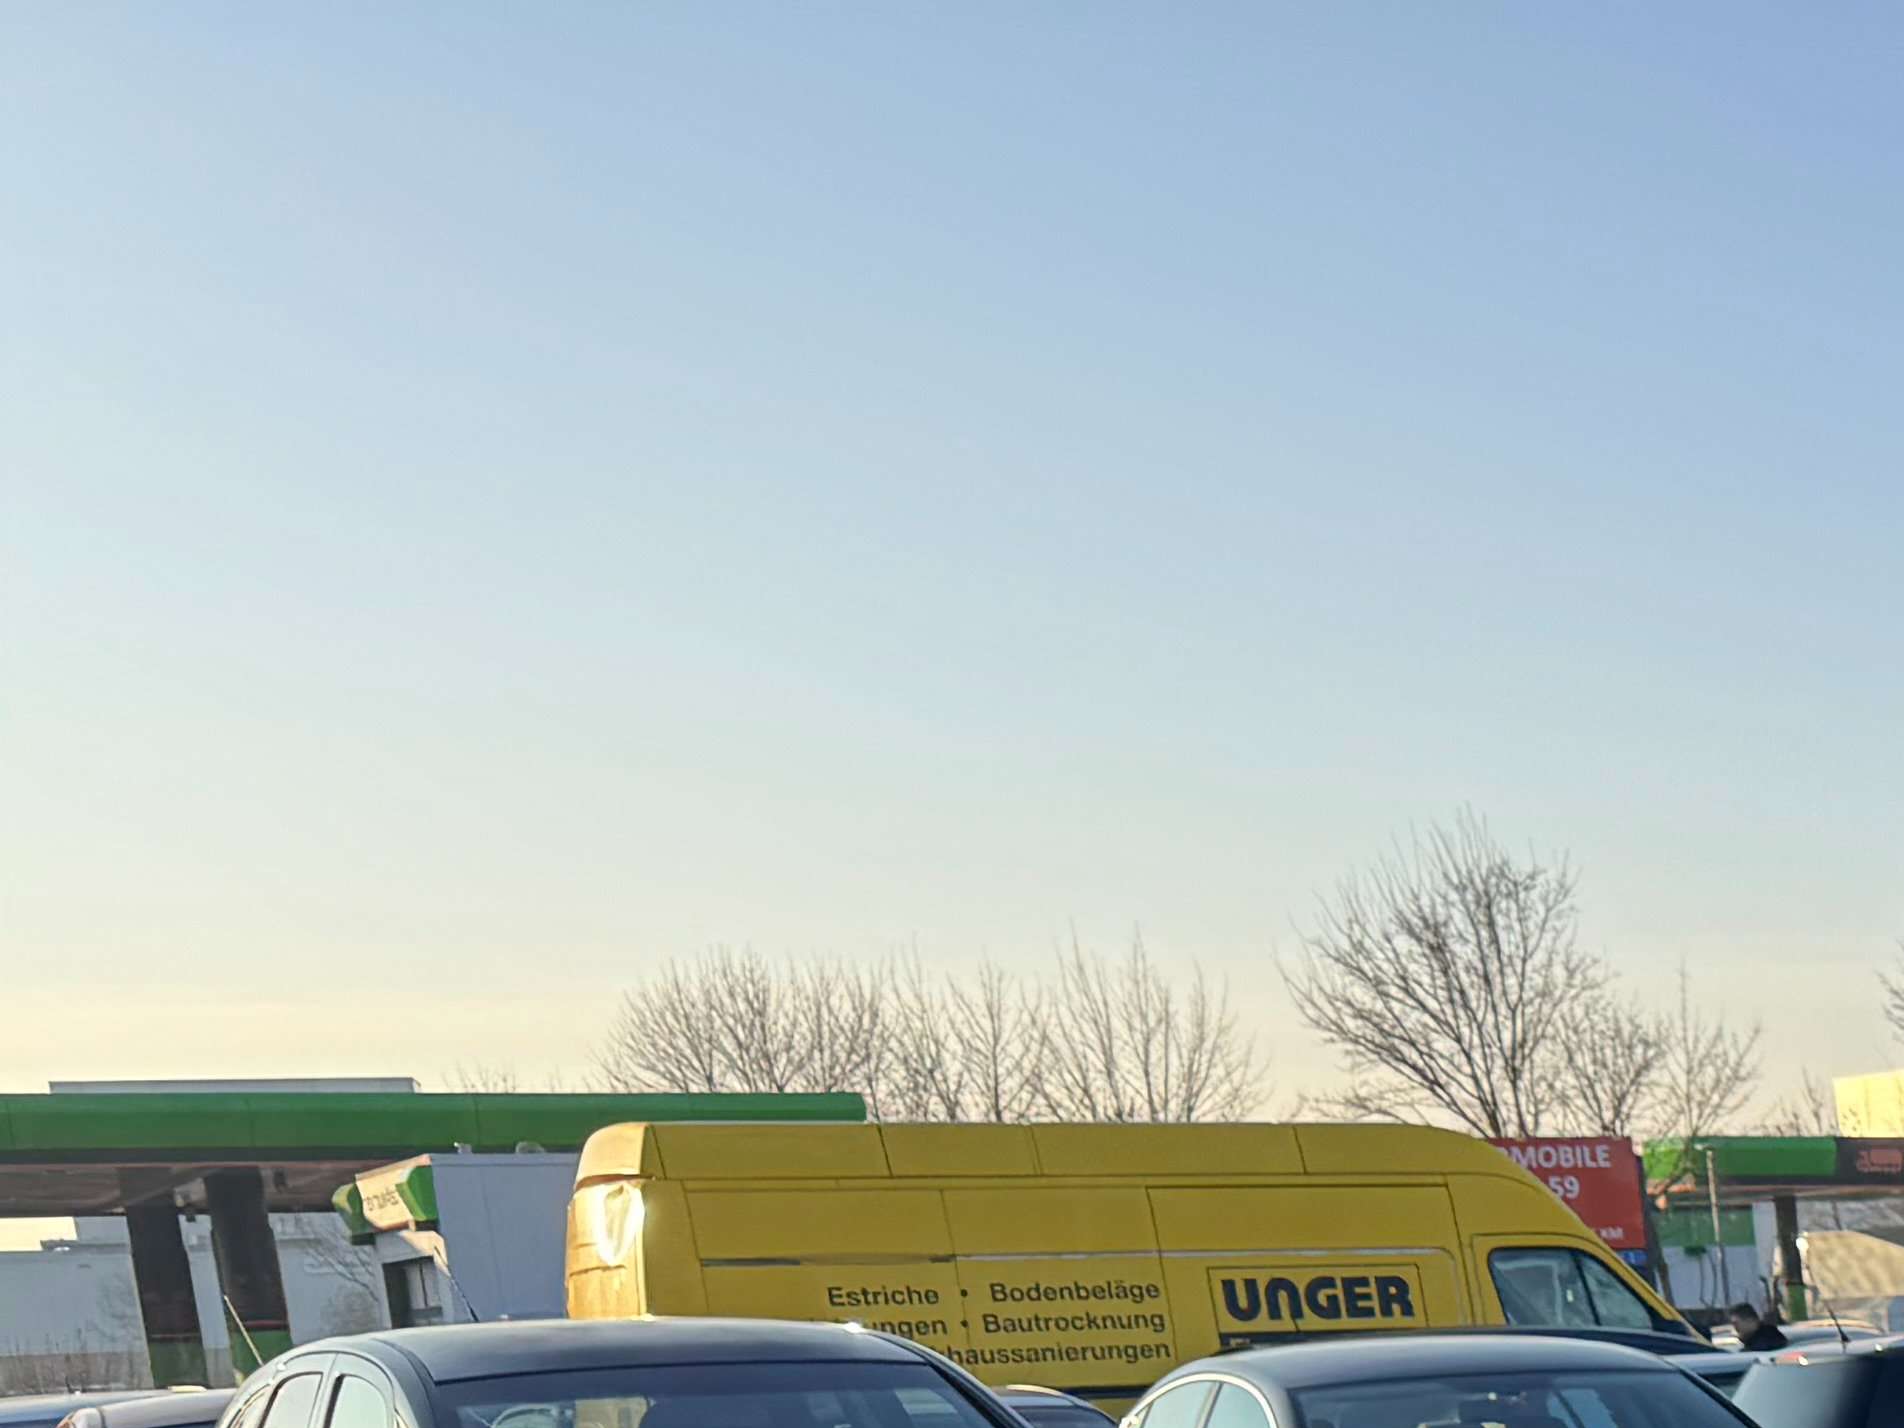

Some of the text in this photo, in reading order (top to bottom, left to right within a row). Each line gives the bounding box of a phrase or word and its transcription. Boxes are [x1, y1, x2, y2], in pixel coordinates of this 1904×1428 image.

[827, 1279, 1161, 1307] Estriche Bodenbeläge
[1221, 1275, 1415, 1322] UNGER
[982, 1312, 1166, 1335] Bautrocknung
